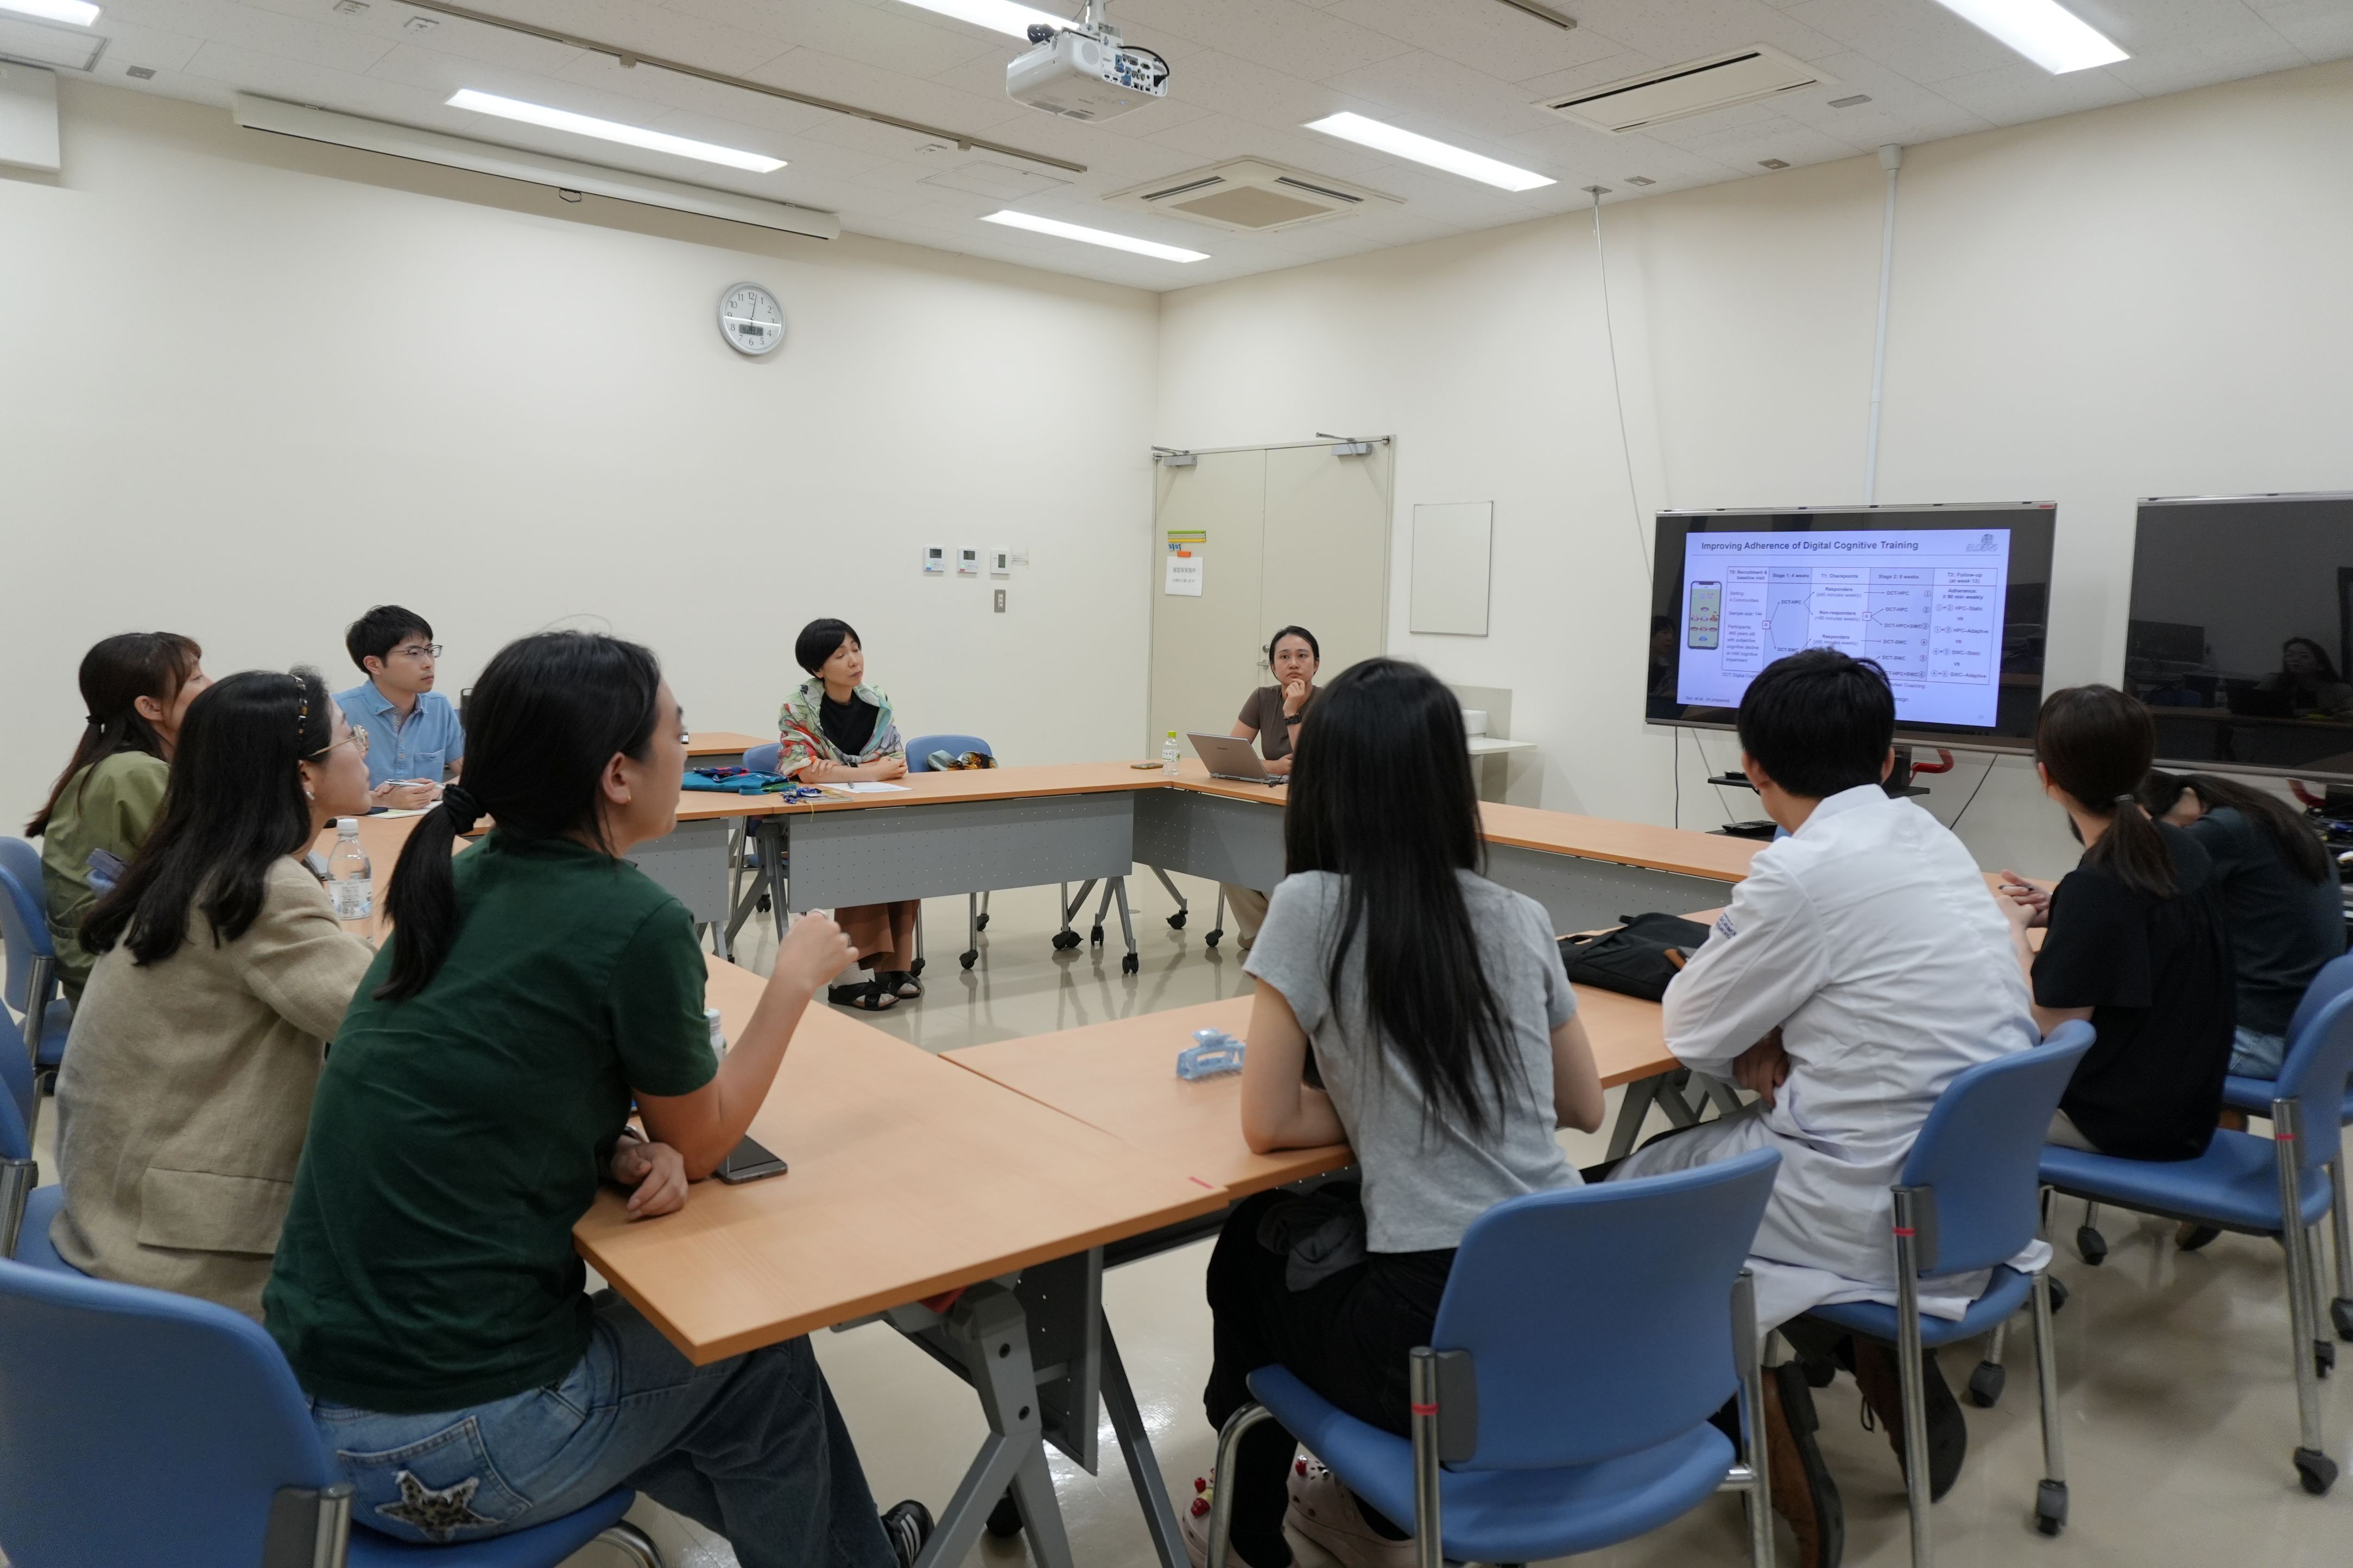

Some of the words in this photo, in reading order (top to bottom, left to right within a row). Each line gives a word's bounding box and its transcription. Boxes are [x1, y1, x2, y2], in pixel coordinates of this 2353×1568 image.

[1702, 542, 1742, 551] Improving
[1744, 542, 1789, 550] Adherence
[1792, 542, 1801, 550] of
[1803, 541, 1831, 551] Digital
[1834, 541, 1877, 551] Cognitive
[1880, 541, 1919, 551] Training
